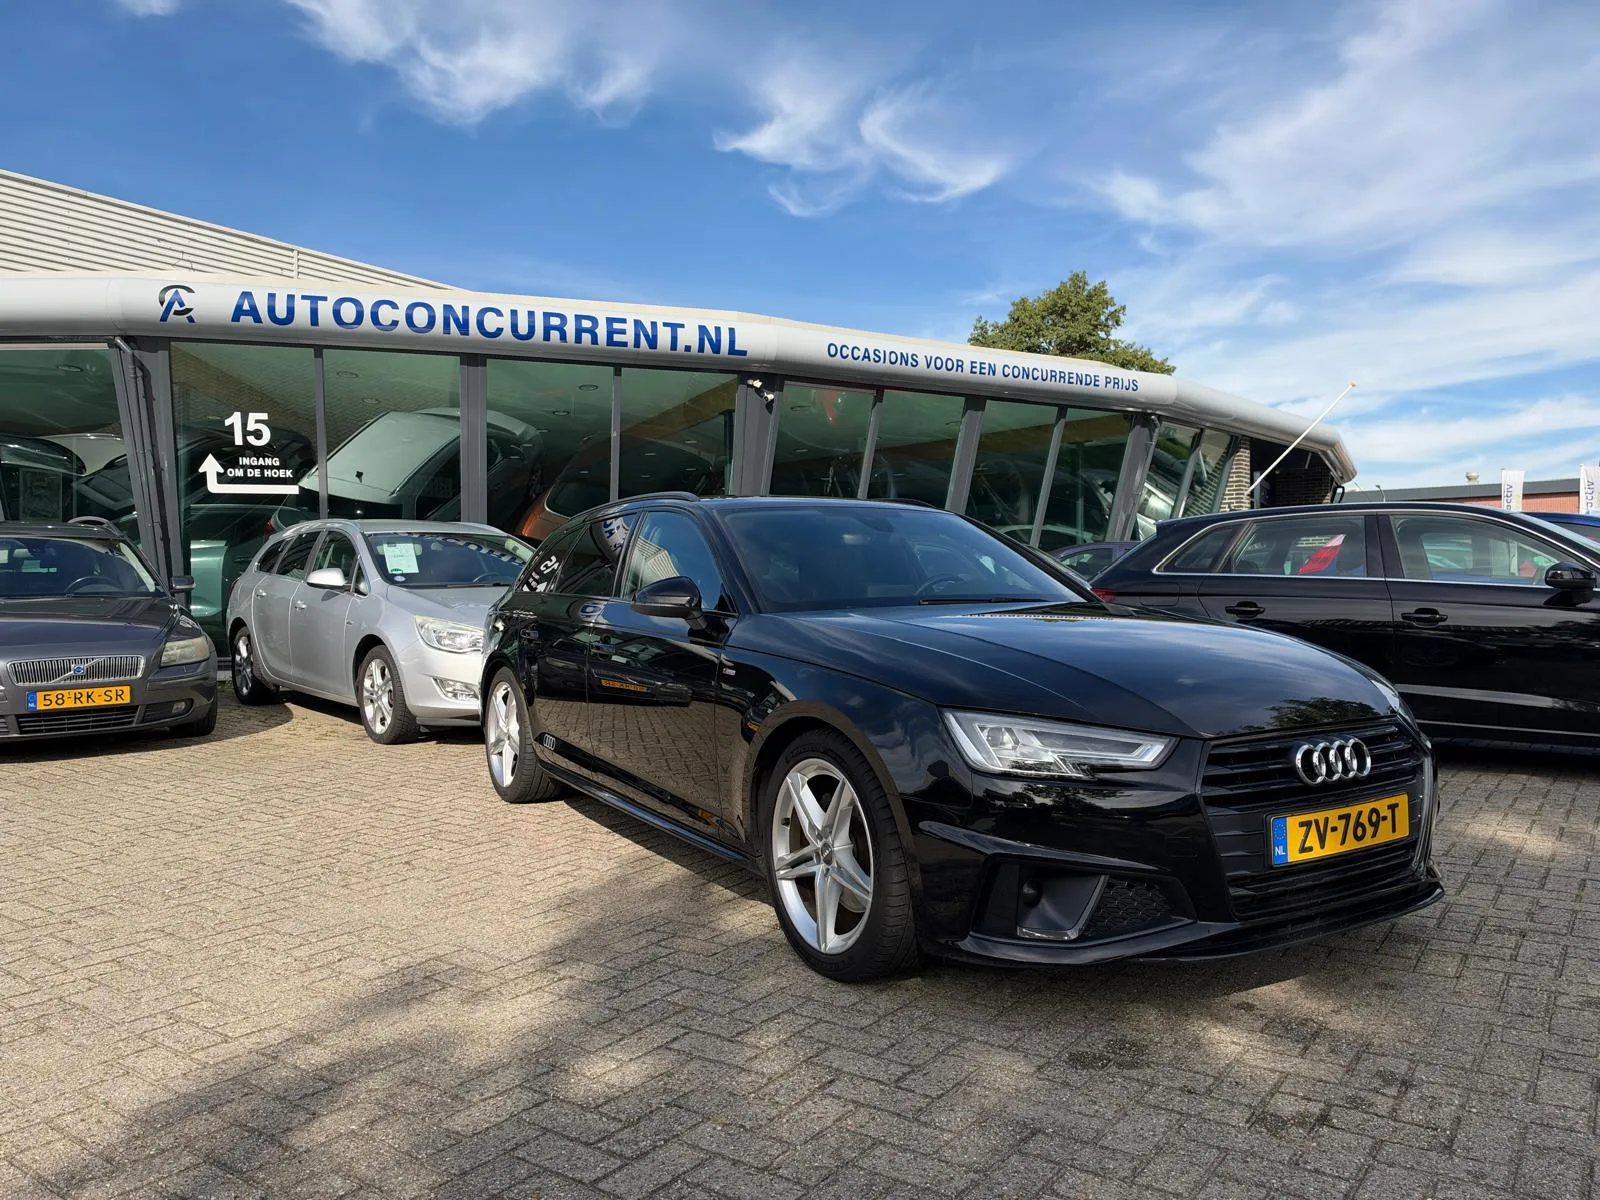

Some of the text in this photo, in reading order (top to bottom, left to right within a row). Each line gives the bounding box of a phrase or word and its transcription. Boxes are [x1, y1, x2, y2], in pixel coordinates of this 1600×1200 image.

[231, 291, 748, 357] AUTOCONCURRENT.NL
[827, 343, 1139, 392] OCCASIONS VOOR EEN CONCURRENDE PRIJS
[224, 411, 271, 447] 15
[226, 468, 293, 478] OM DE HOEK
[238, 456, 280, 466] INGANG
[43, 689, 125, 707] 58-RK-SR
[1274, 802, 1399, 856] NL ZV-769-T
